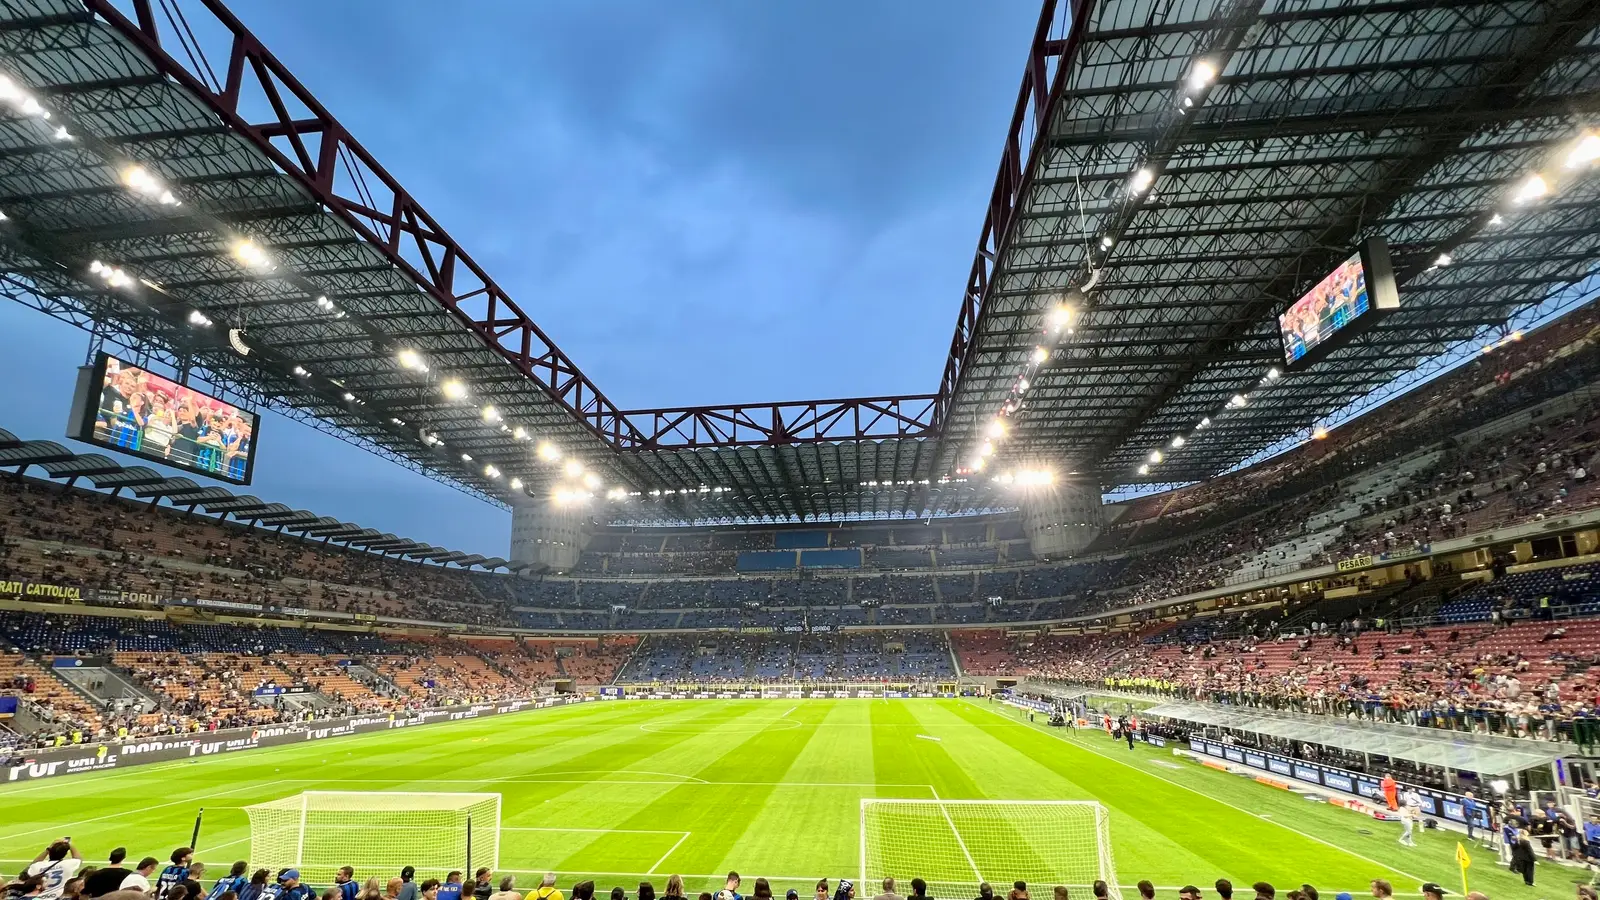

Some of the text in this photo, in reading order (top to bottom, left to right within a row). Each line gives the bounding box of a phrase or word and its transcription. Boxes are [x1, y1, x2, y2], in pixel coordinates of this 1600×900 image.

[26, 583, 80, 598] CATTOLICA
[1270, 762, 1290, 773] Lenovo
[1296, 768, 1318, 780] Lenovo
[1326, 776, 1350, 788] Lenovo
